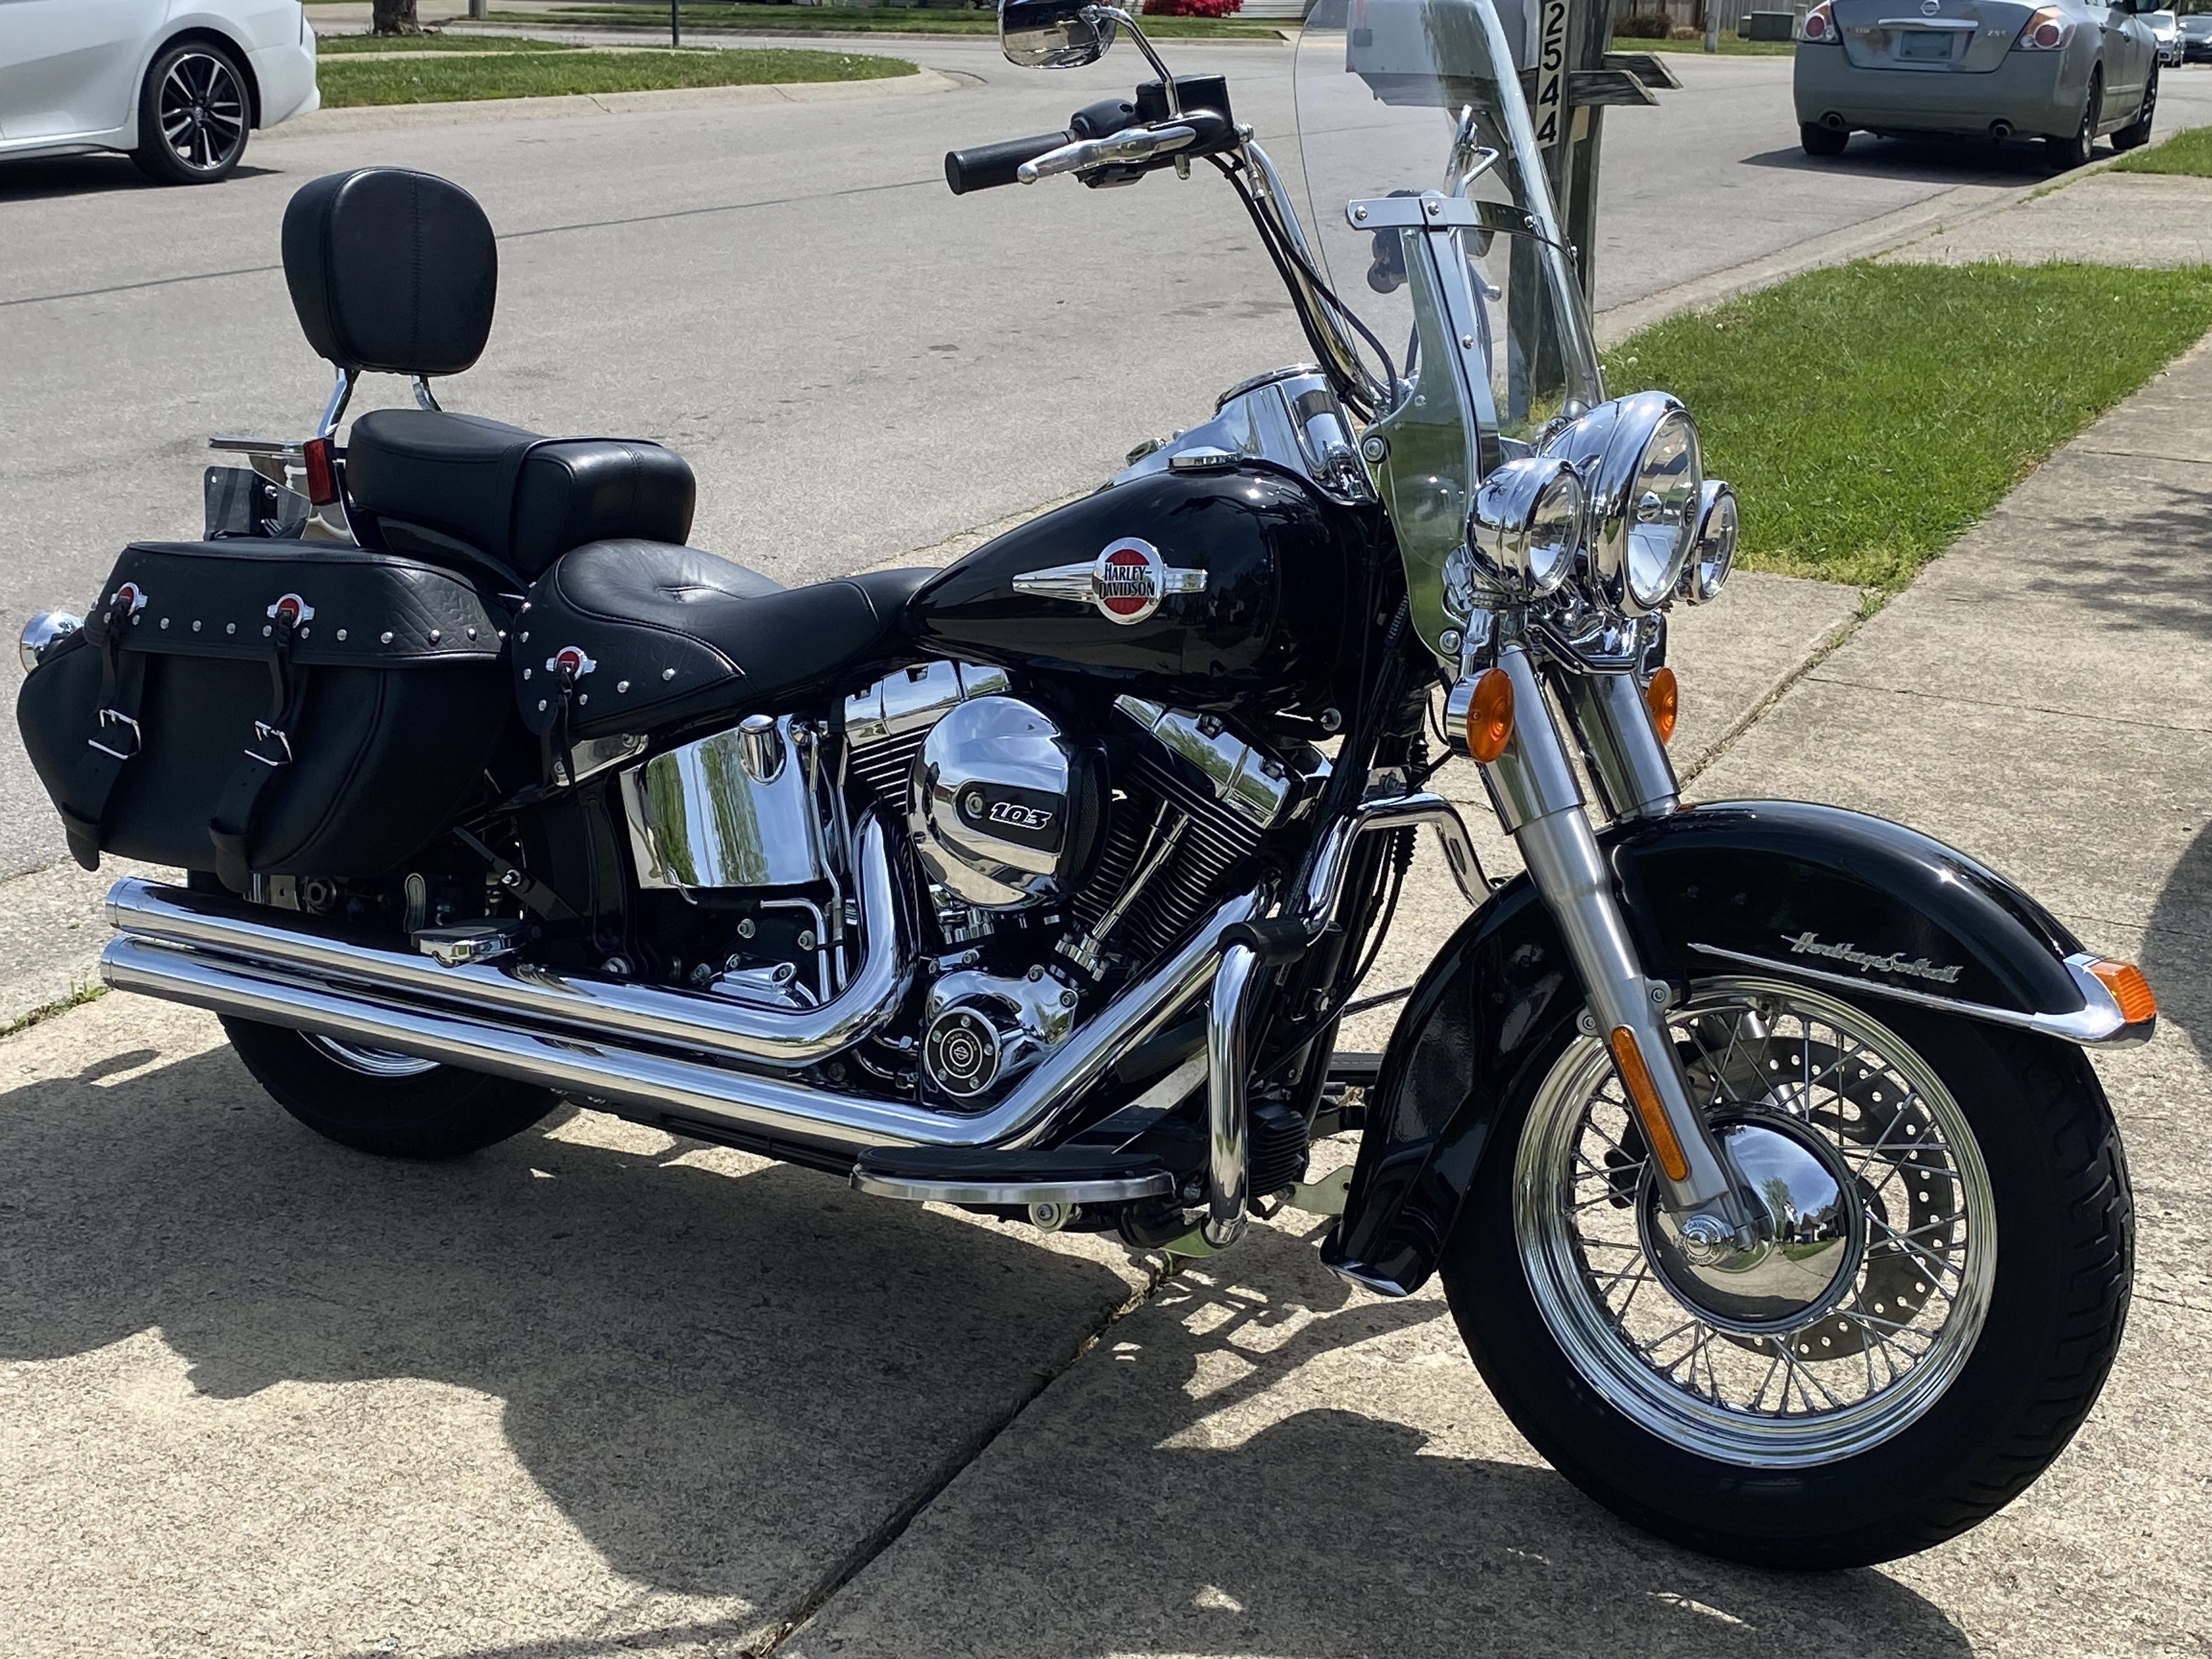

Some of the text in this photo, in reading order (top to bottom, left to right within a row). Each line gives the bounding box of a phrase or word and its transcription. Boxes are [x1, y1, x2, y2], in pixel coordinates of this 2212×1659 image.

[1537, 3, 1565, 143] 2544
[1104, 563, 1152, 582] HARLEY-
[1099, 582, 1155, 600] DAVIDSON
[989, 802, 1052, 830] 103
